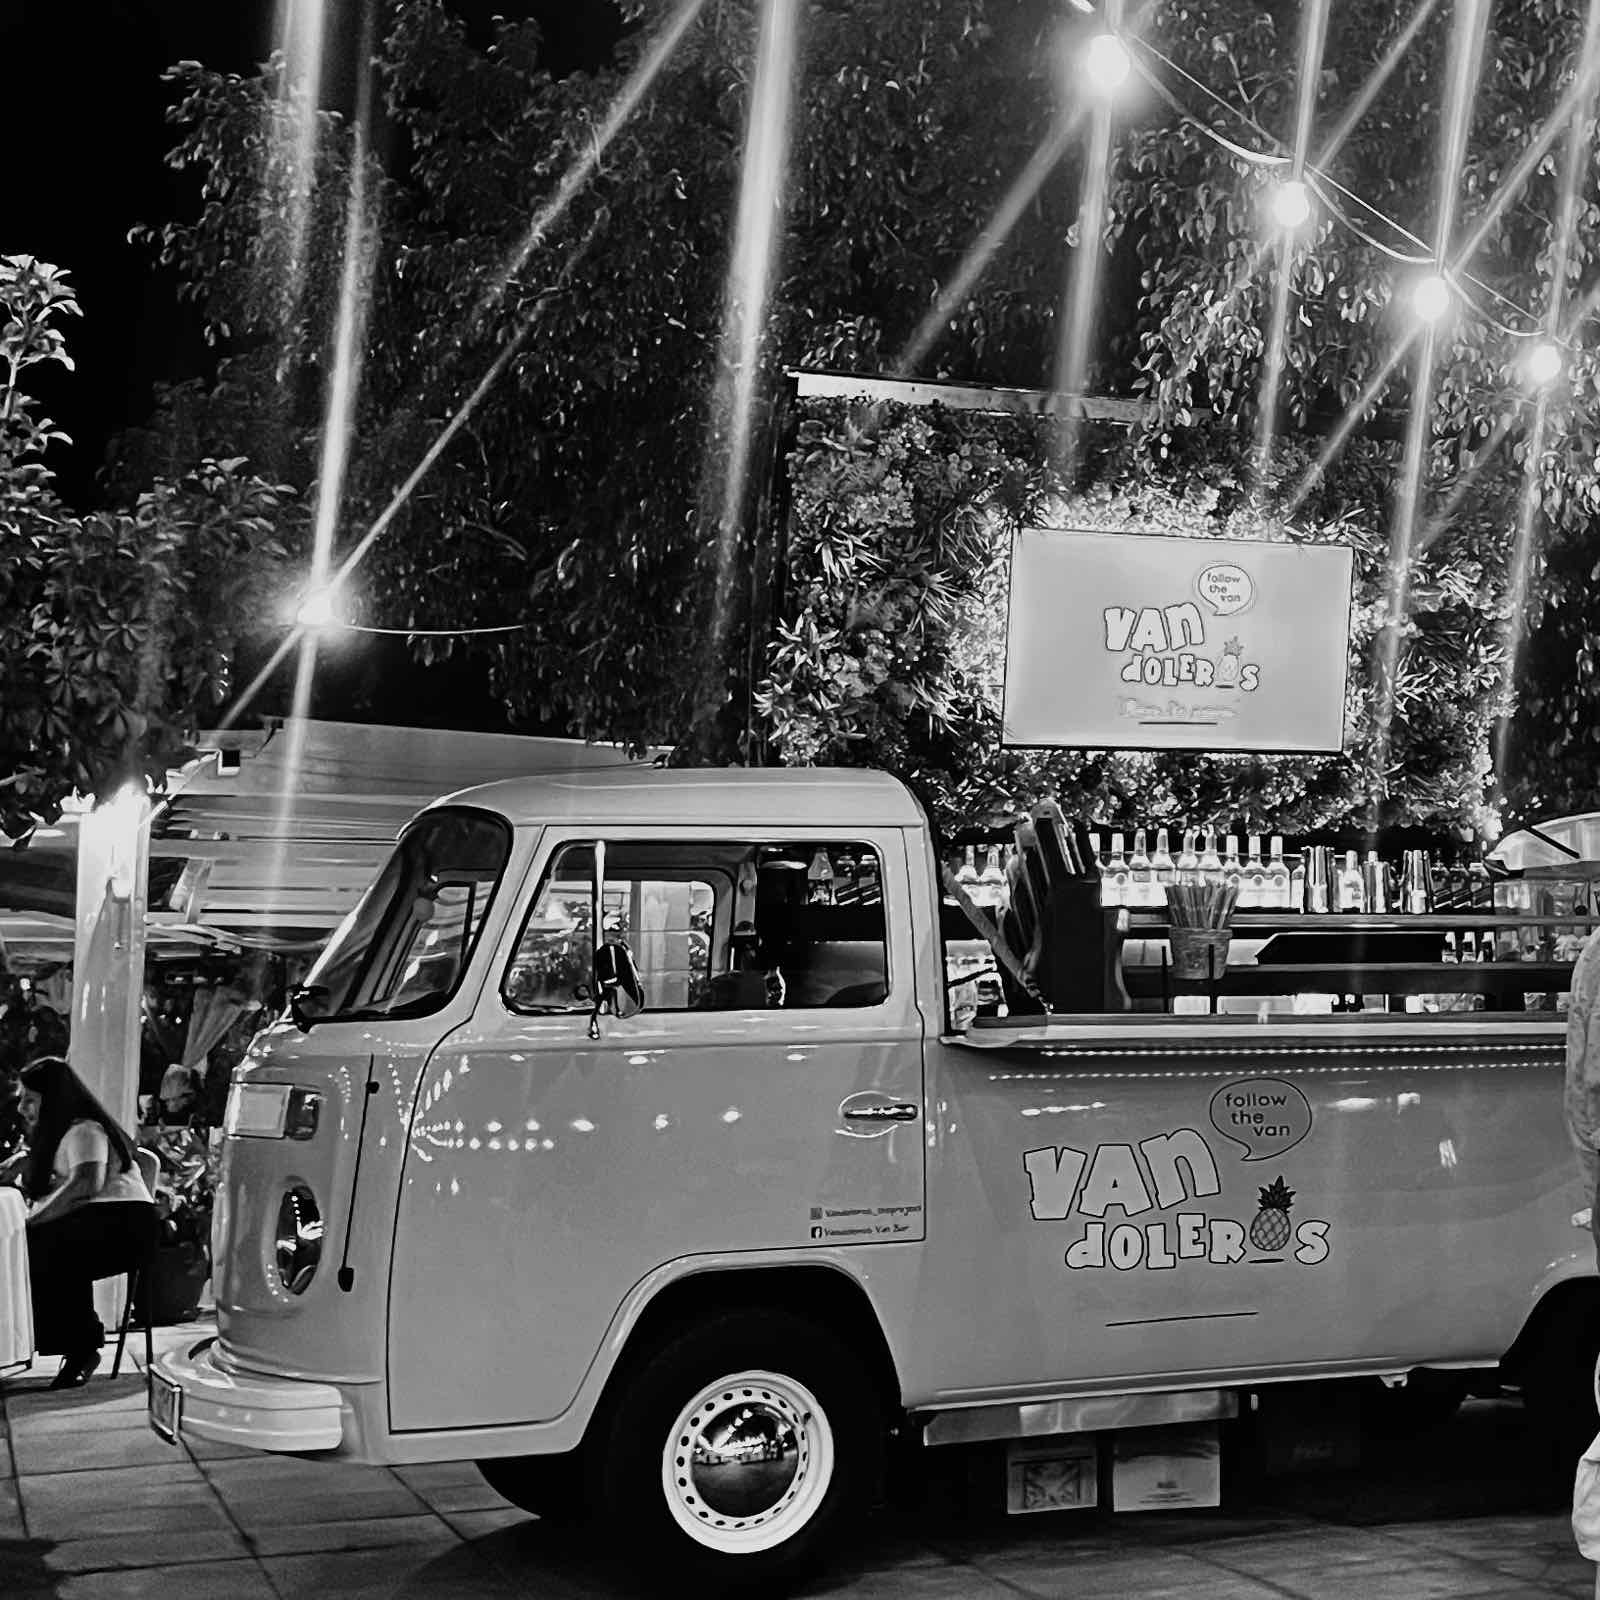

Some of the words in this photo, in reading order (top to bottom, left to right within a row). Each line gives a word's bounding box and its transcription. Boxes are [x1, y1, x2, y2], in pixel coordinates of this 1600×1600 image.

[1207, 572, 1241, 583] follow
[1209, 584, 1228, 593] the
[1220, 594, 1241, 602] van
[1225, 1092, 1287, 1108] follow
[1231, 1110, 1264, 1125] the
[1253, 1125, 1290, 1137] van
[1023, 1127, 1221, 1221] VAn
